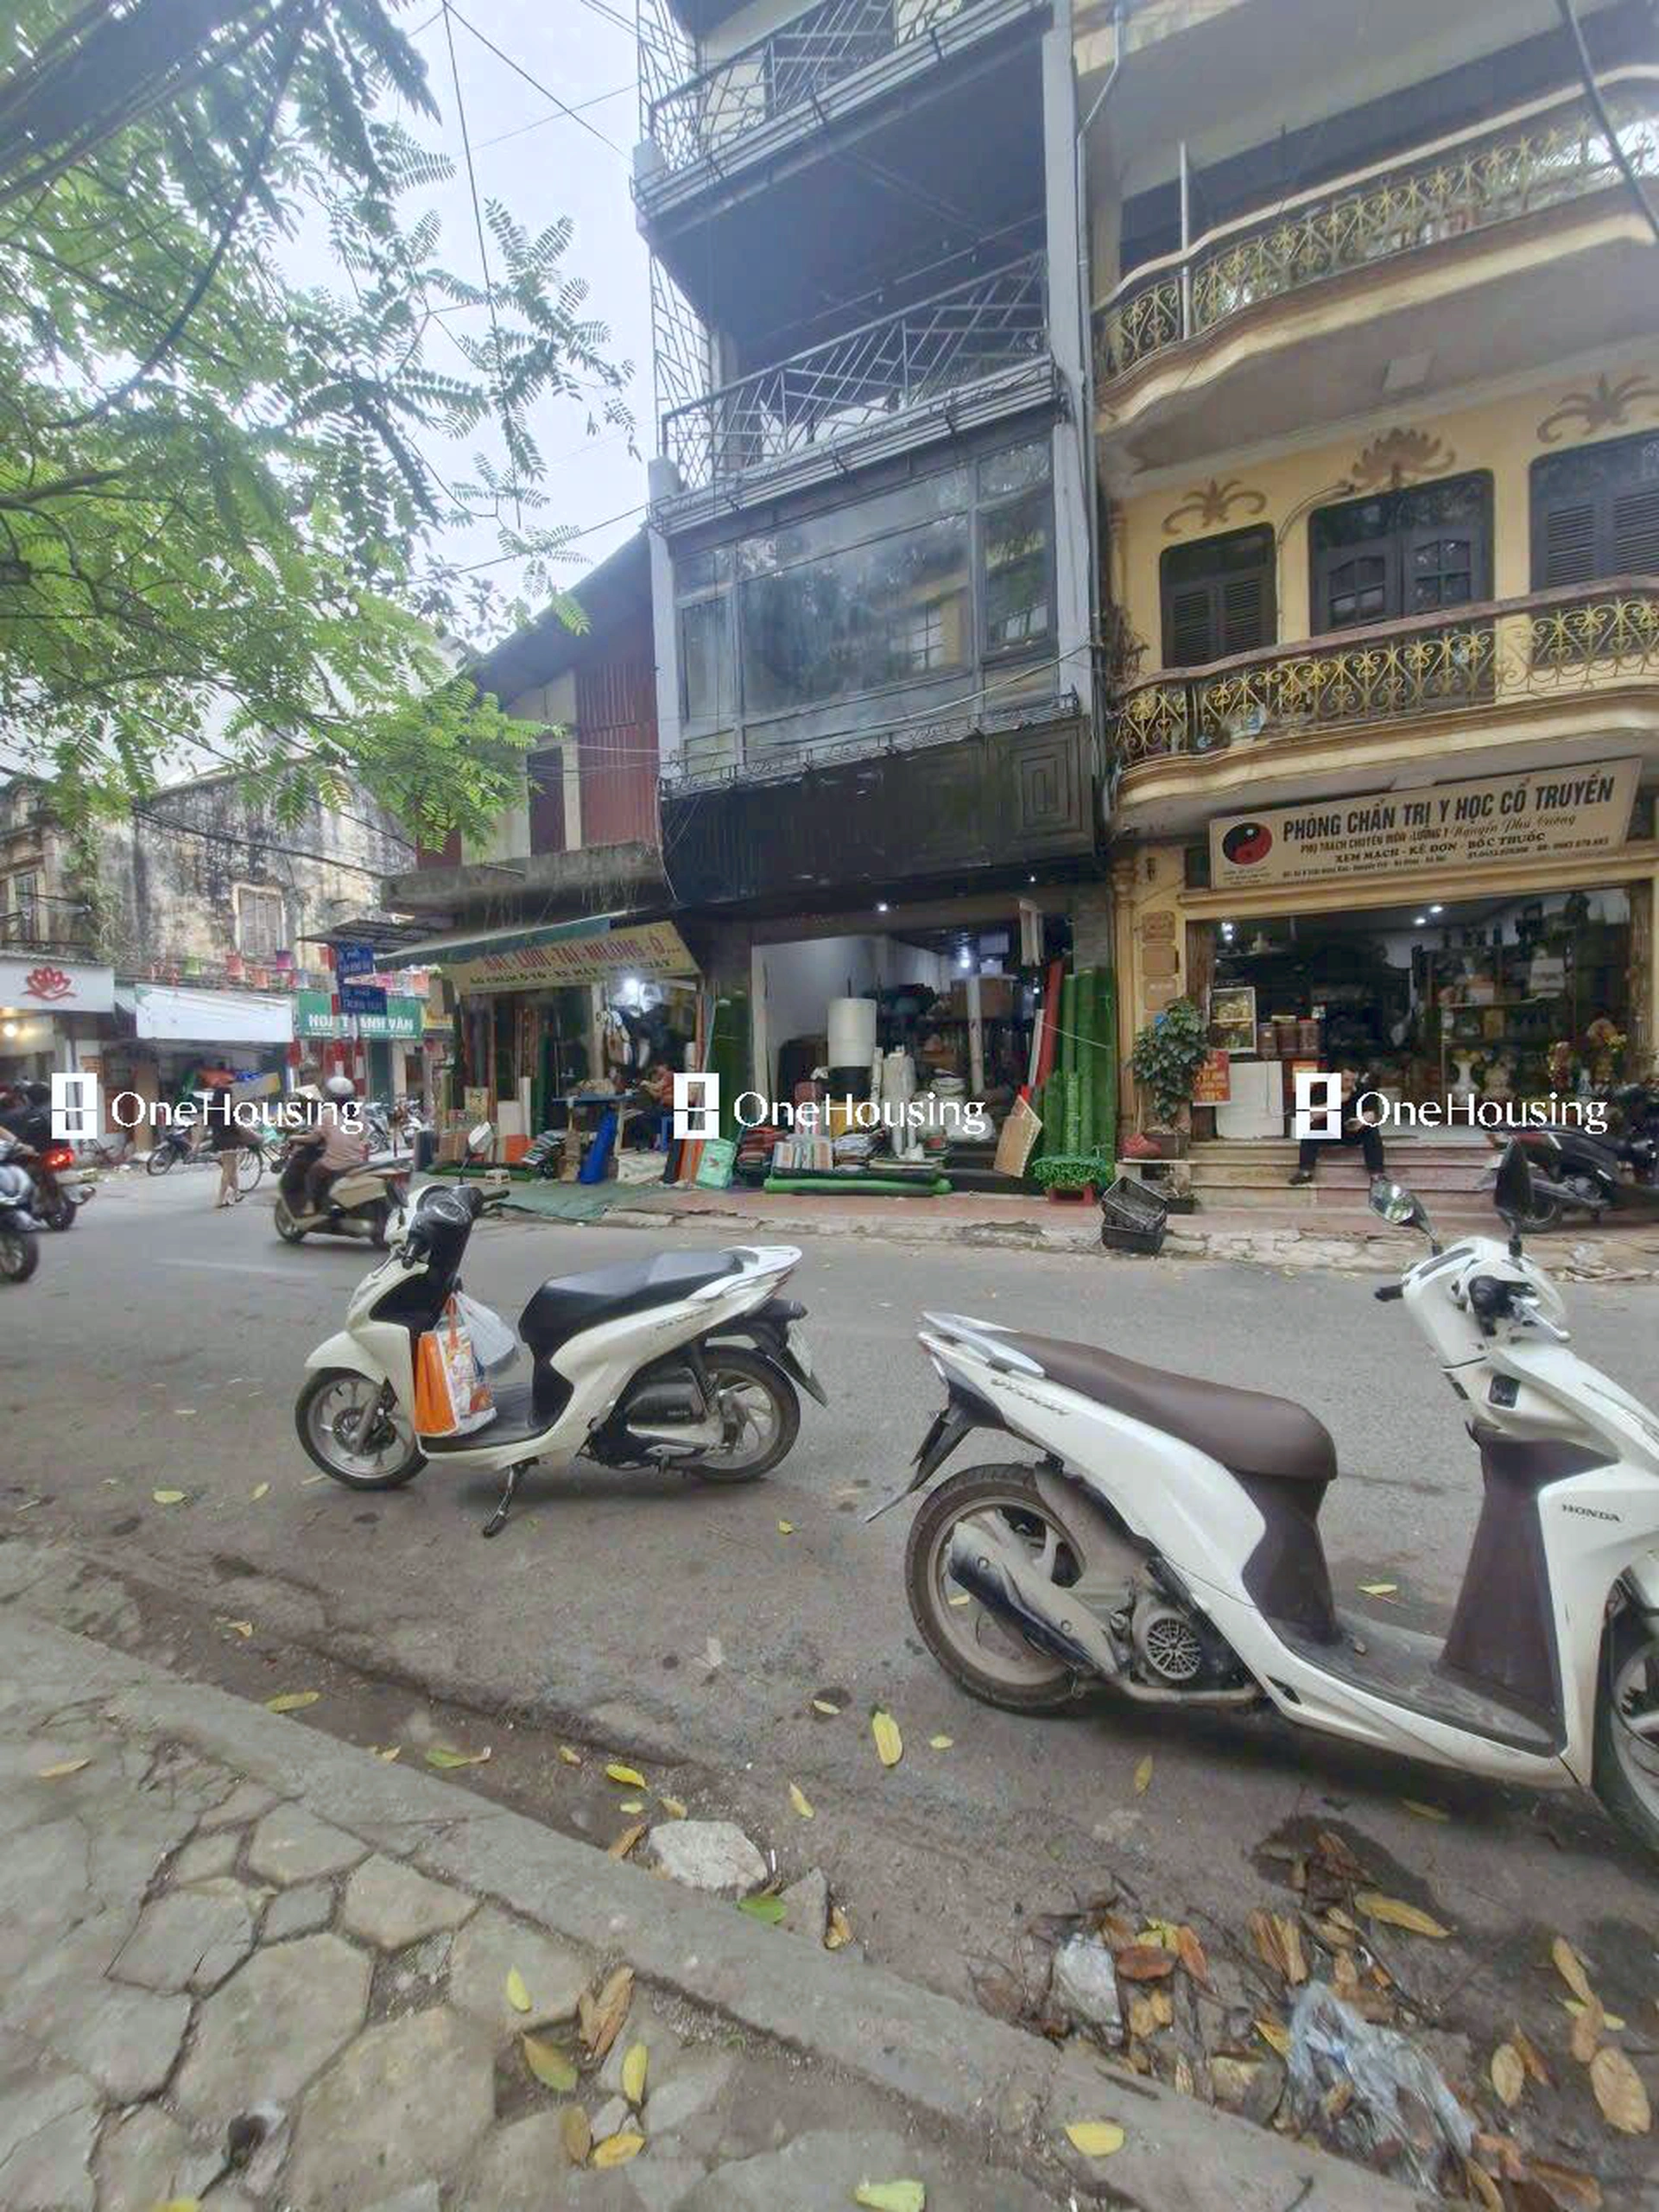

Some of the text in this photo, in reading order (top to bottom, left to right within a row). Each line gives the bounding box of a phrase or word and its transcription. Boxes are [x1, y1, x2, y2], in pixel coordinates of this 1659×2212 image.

[1283, 812, 1342, 841] PHÒNG
[1403, 801, 1431, 827] TRỊ
[1440, 800, 1450, 822] Y
[1455, 793, 1494, 823] HỌC
[1500, 776, 1530, 814] CỔ
[1536, 770, 1615, 811] TRUYỀN
[1336, 852, 1359, 864] XEM
[1363, 848, 1399, 861] MẠCH
[1409, 845, 1425, 856] KÊ
[1430, 841, 1457, 853] ĐƠN
[1468, 834, 1496, 849] BỐC
[1498, 829, 1546, 846] THUỐC
[1562, 1505, 1620, 1522] HONDA
